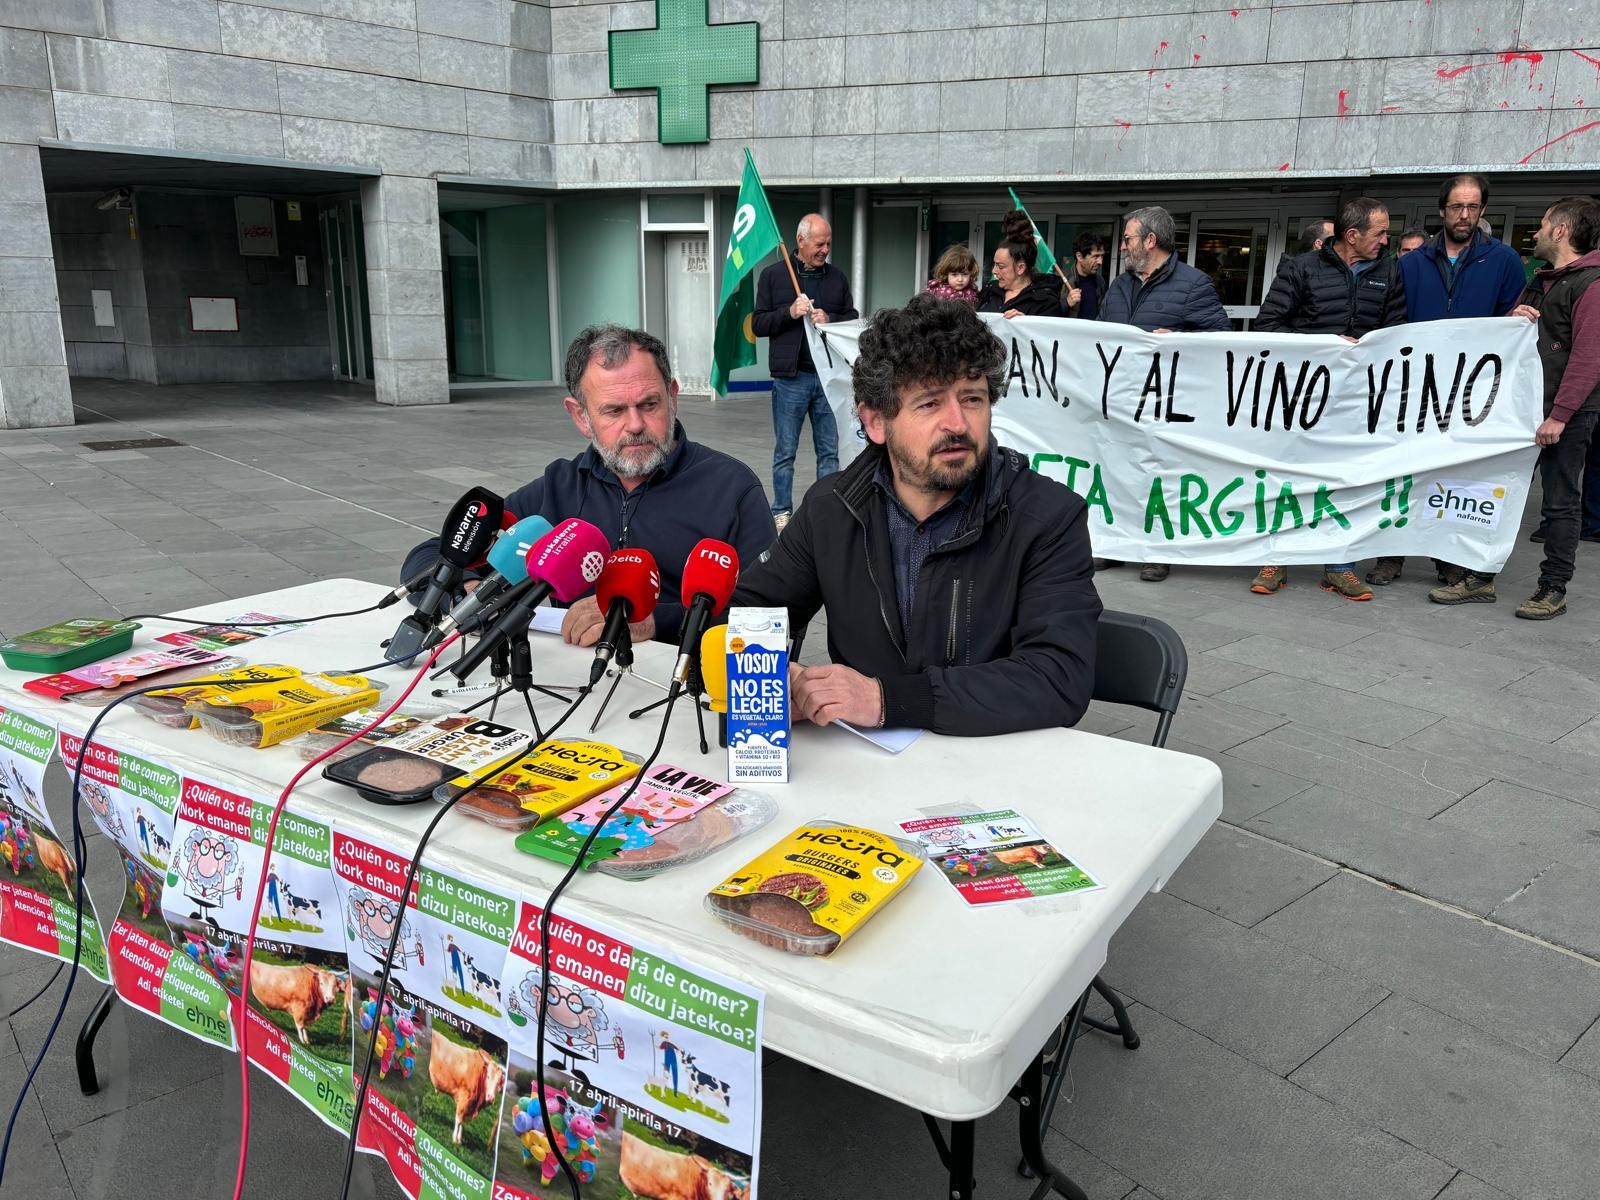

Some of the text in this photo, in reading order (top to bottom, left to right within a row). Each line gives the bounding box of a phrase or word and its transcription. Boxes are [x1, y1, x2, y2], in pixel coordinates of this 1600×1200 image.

[1096, 342, 1122, 420] Y
[1134, 351, 1196, 423] AL
[1428, 490, 1495, 516] ehne
[1457, 512, 1491, 525] nafarroa
[451, 504, 479, 549] Navarra
[462, 521, 481, 553] televisión
[537, 521, 579, 567] euskalerria
[553, 532, 577, 556] irratia
[700, 549, 732, 569] rne
[735, 653, 779, 674] YOSOY
[731, 679, 784, 697] NO ES
[731, 698, 784, 714] LECHE
[11, 715, 53, 741] de comer?
[464, 720, 517, 738] B
[0, 729, 51, 760] dizu jatekoa?
[95, 748, 106, 761] os
[107, 749, 128, 768] dará
[129, 760, 141, 774] de
[141, 765, 177, 788] comer?
[652, 767, 723, 796] LA VIE
[83, 763, 119, 784] emanen
[121, 774, 137, 790] dizu
[138, 781, 177, 809] jatekoa?
[643, 780, 672, 792] JAMBON
[185, 784, 221, 808] ¿Quién
[222, 798, 235, 812] os
[237, 801, 263, 822] dará
[284, 816, 325, 841] comer?
[180, 801, 205, 822] Nork
[207, 813, 251, 837] emanen
[279, 833, 330, 864] jatekoa?
[795, 856, 850, 876] ORIGINALES
[803, 848, 860, 869] BURGERS
[339, 840, 382, 868] ¿Quién
[385, 858, 401, 874] os
[437, 874, 454, 896] de
[457, 885, 509, 918] comer?
[14, 899, 46, 919] Atención
[334, 856, 364, 882] Nork
[421, 892, 449, 916] dizu
[450, 903, 514, 942] jatekoa?
[36, 922, 49, 935] Adi
[205, 926, 216, 937] 17
[280, 943, 293, 954] 17
[113, 921, 195, 974] Zer jaten duzu? ¿Qué
[119, 945, 212, 1005] Atención al etiquetado.
[586, 933, 606, 957] os
[609, 943, 650, 977] dará
[652, 960, 676, 988] de
[679, 975, 750, 1019] comer?
[137, 976, 185, 1009] Adi etiketei
[555, 953, 627, 994] emanen
[630, 982, 667, 1012] dizu
[667, 998, 756, 1046] jatekoa?
[186, 1004, 227, 1034] ehne
[390, 986, 472, 1033] 17 abril-apirila 17
[266, 1038, 281, 1057] Adi
[282, 1052, 316, 1082] etiketei
[316, 1081, 354, 1120] ehne
[568, 1079, 682, 1139] 17 abril-apirila 17
[368, 1089, 390, 1117] jaten
[391, 1110, 418, 1139] duzu?
[418, 1136, 443, 1162] ¿Qué
[444, 1157, 486, 1194] comes?
[397, 1146, 412, 1167] Adi
